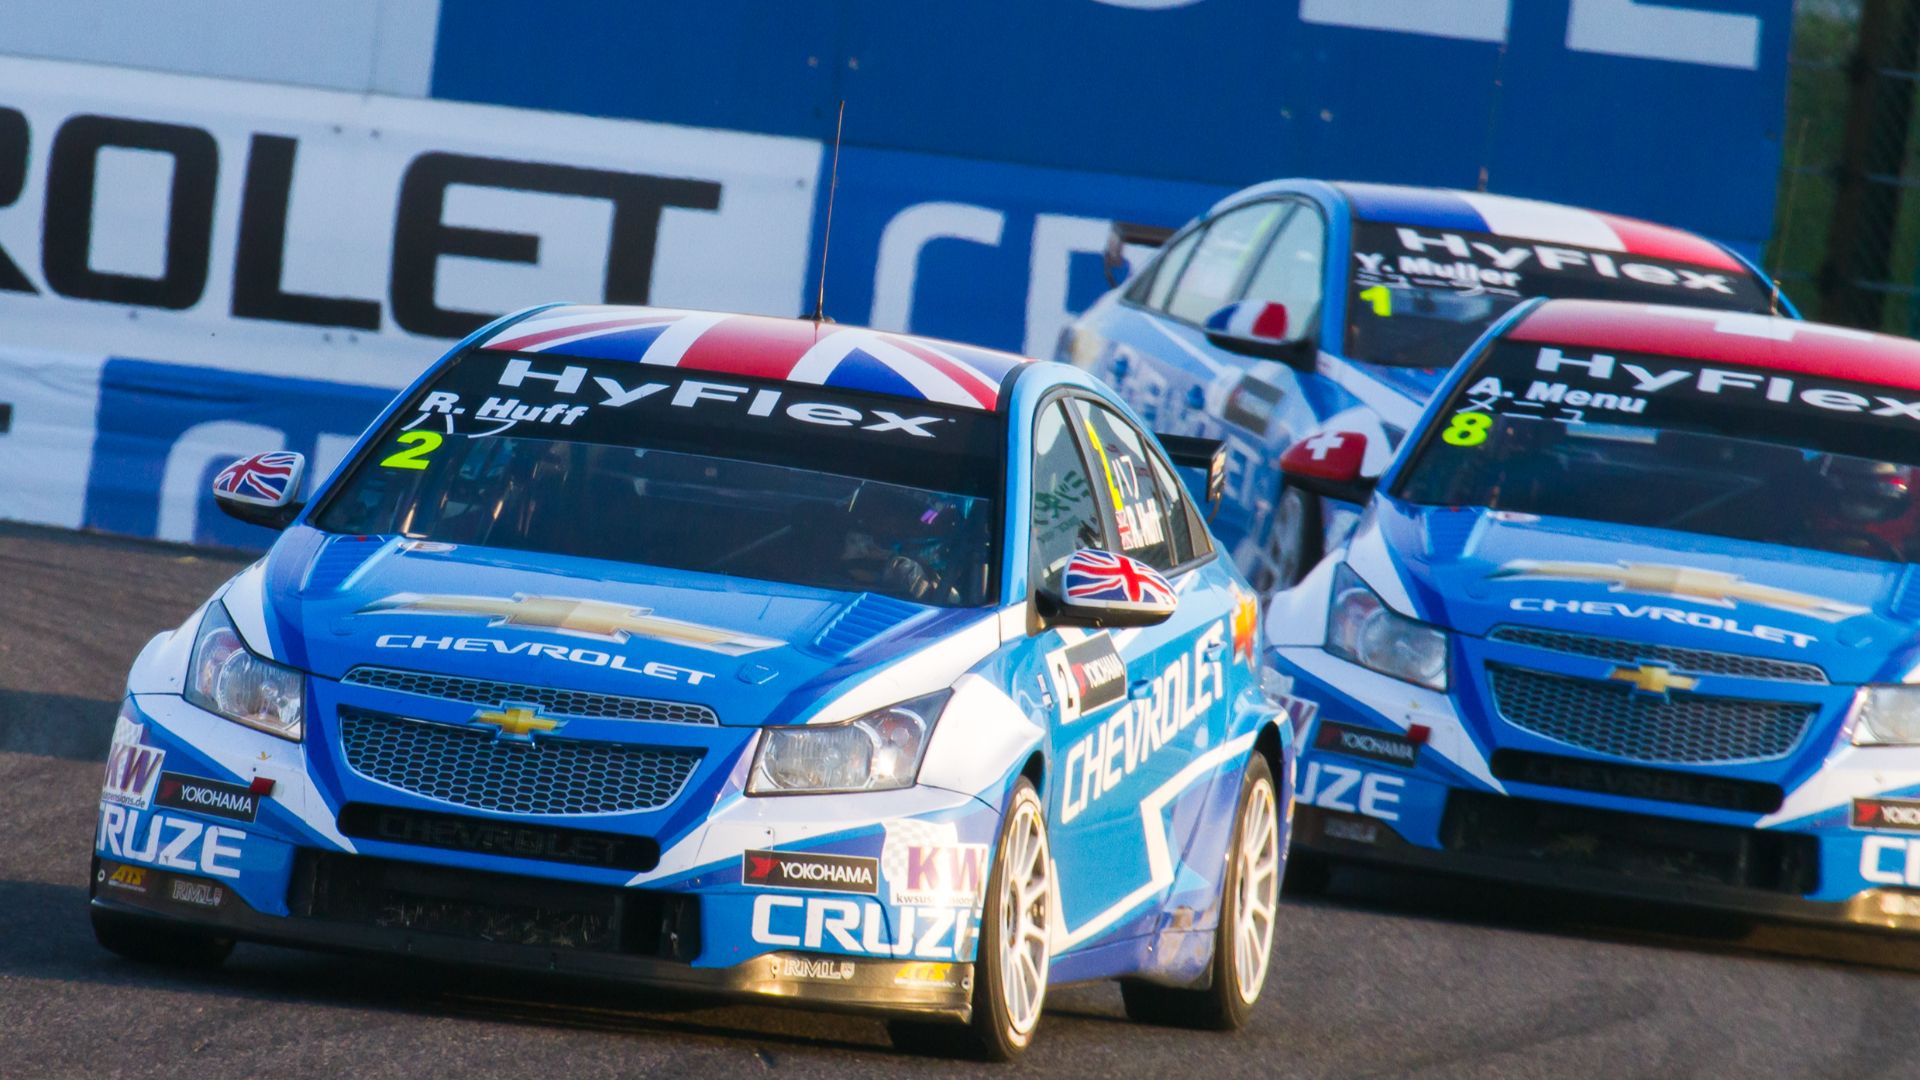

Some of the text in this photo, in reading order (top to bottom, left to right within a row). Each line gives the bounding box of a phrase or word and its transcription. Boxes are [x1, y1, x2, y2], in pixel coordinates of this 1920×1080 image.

[0, 107, 721, 338] OLET
[1396, 227, 1735, 295] HyFlex
[1398, 256, 1522, 288] Muller
[1360, 284, 1392, 317] 1
[418, 391, 589, 426] R. Huff
[498, 358, 945, 438] HyFlex
[1466, 376, 1647, 414] A. Menu
[1536, 347, 1920, 421] HyFlex
[379, 430, 443, 470] 2
[1441, 412, 1493, 447] 8
[1510, 597, 1818, 649] CHEVROLET
[375, 633, 715, 687] CHEVROLET
[1061, 618, 1225, 825] CHEVROLET
[181, 784, 252, 813] YOKOHAMA
[97, 803, 247, 879] RUZE
[1859, 835, 1920, 886] C
[780, 861, 873, 885] YOKOHAMA
